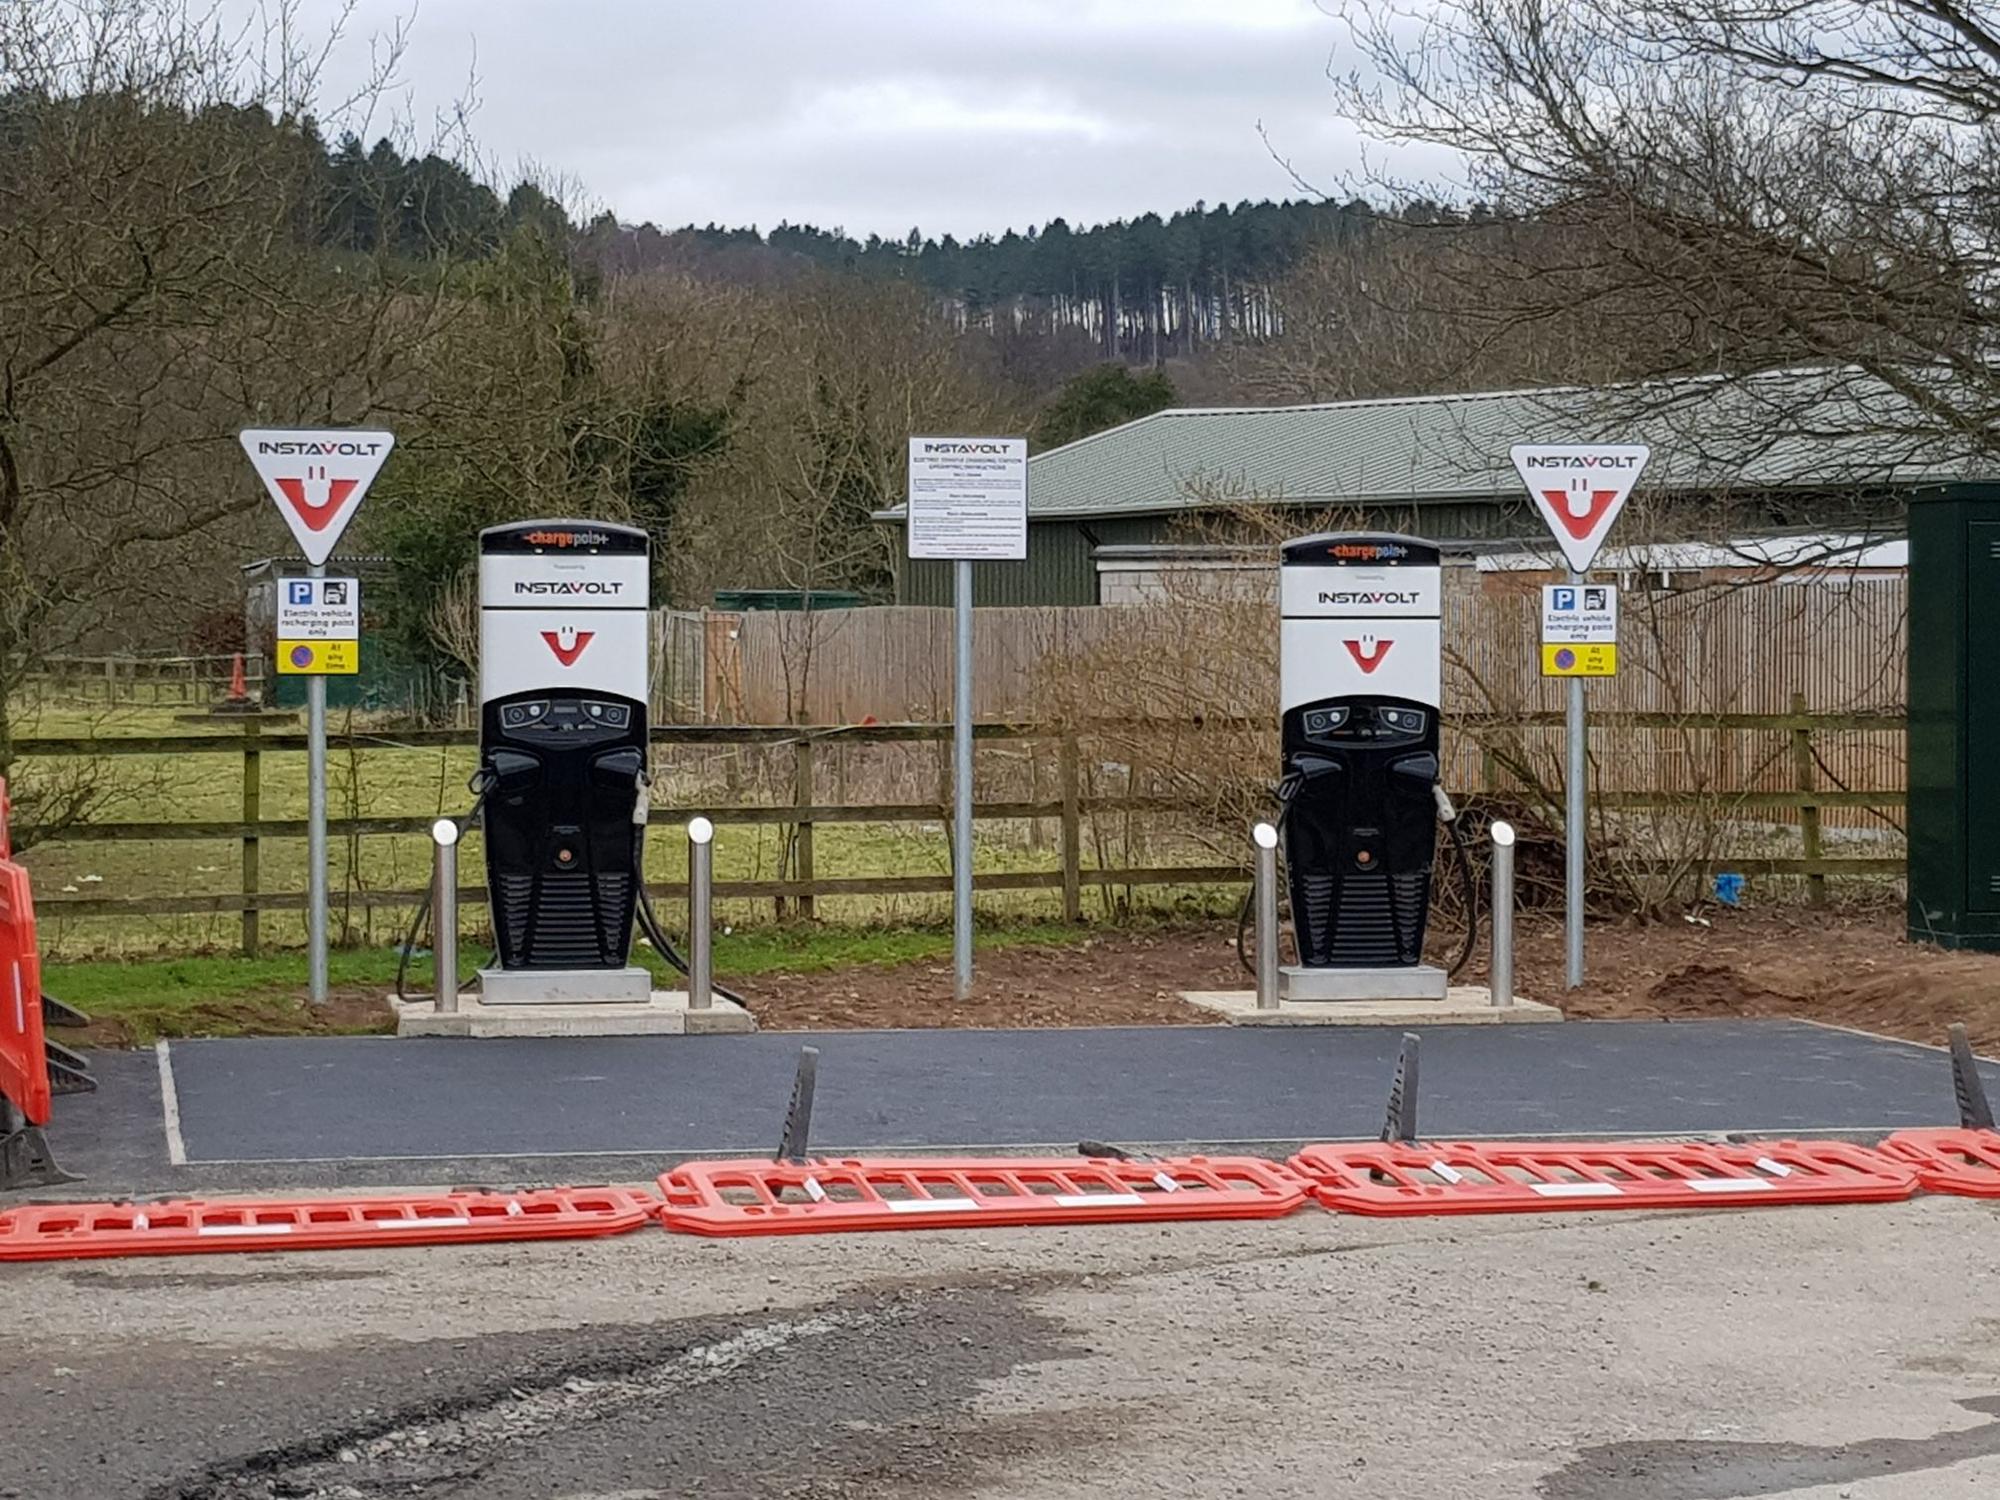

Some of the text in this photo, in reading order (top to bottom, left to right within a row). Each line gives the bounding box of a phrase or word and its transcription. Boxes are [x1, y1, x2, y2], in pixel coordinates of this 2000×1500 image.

[259, 441, 382, 456] INSTAVOLT
[924, 444, 1010, 454] INSTAVOLT
[1527, 455, 1638, 468] INSTAVOLT
[294, 584, 310, 603] P
[515, 582, 623, 594] INSTAVOLT
[1319, 592, 1420, 603] INSTAVOLT
[1557, 590, 1573, 609] P
[1548, 614, 1611, 622] Electric vehicle
